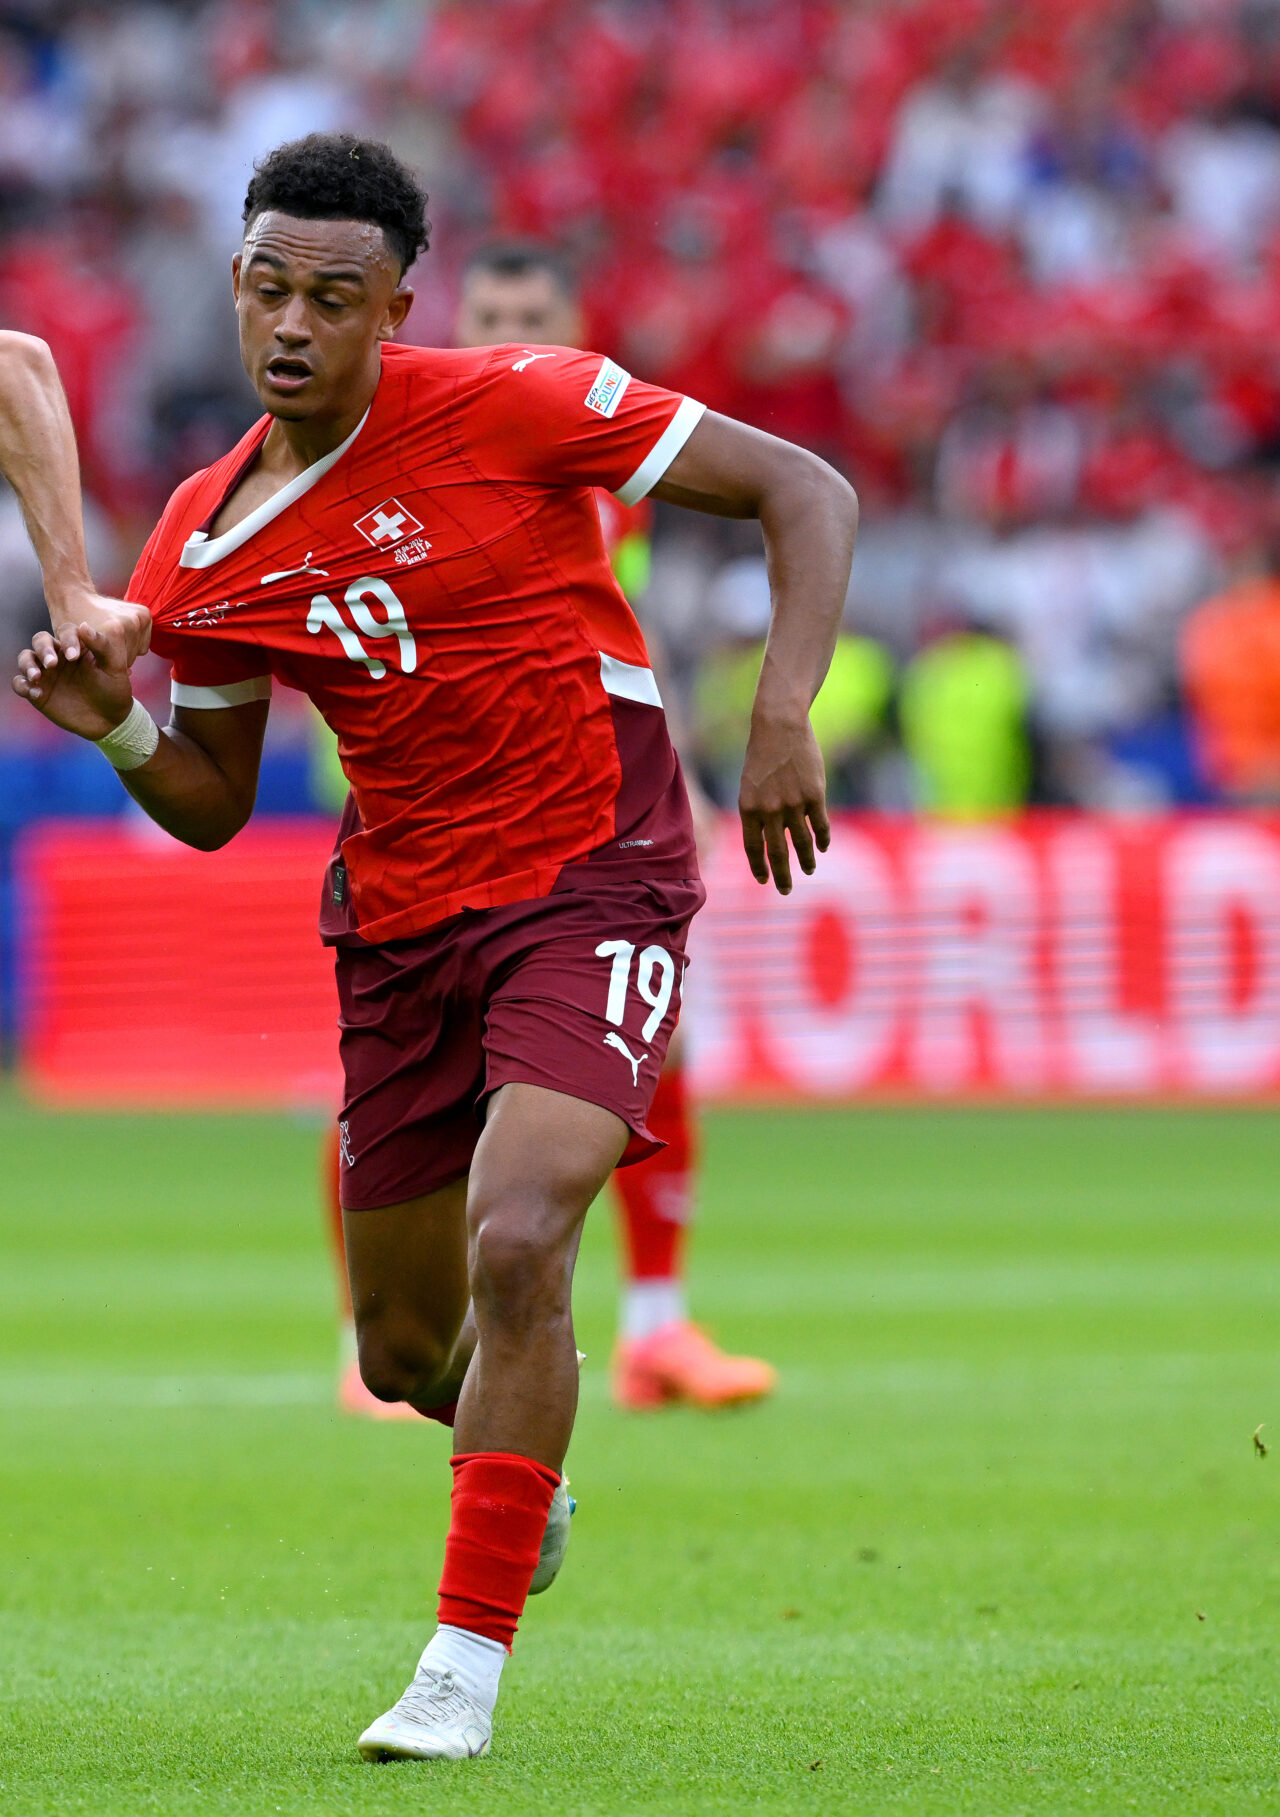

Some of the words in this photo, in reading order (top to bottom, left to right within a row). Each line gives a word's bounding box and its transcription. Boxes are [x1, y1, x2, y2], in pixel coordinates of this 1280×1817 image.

[587, 388, 599, 405] UEFA
[306, 576, 417, 680] 19
[595, 940, 675, 1043] 19
